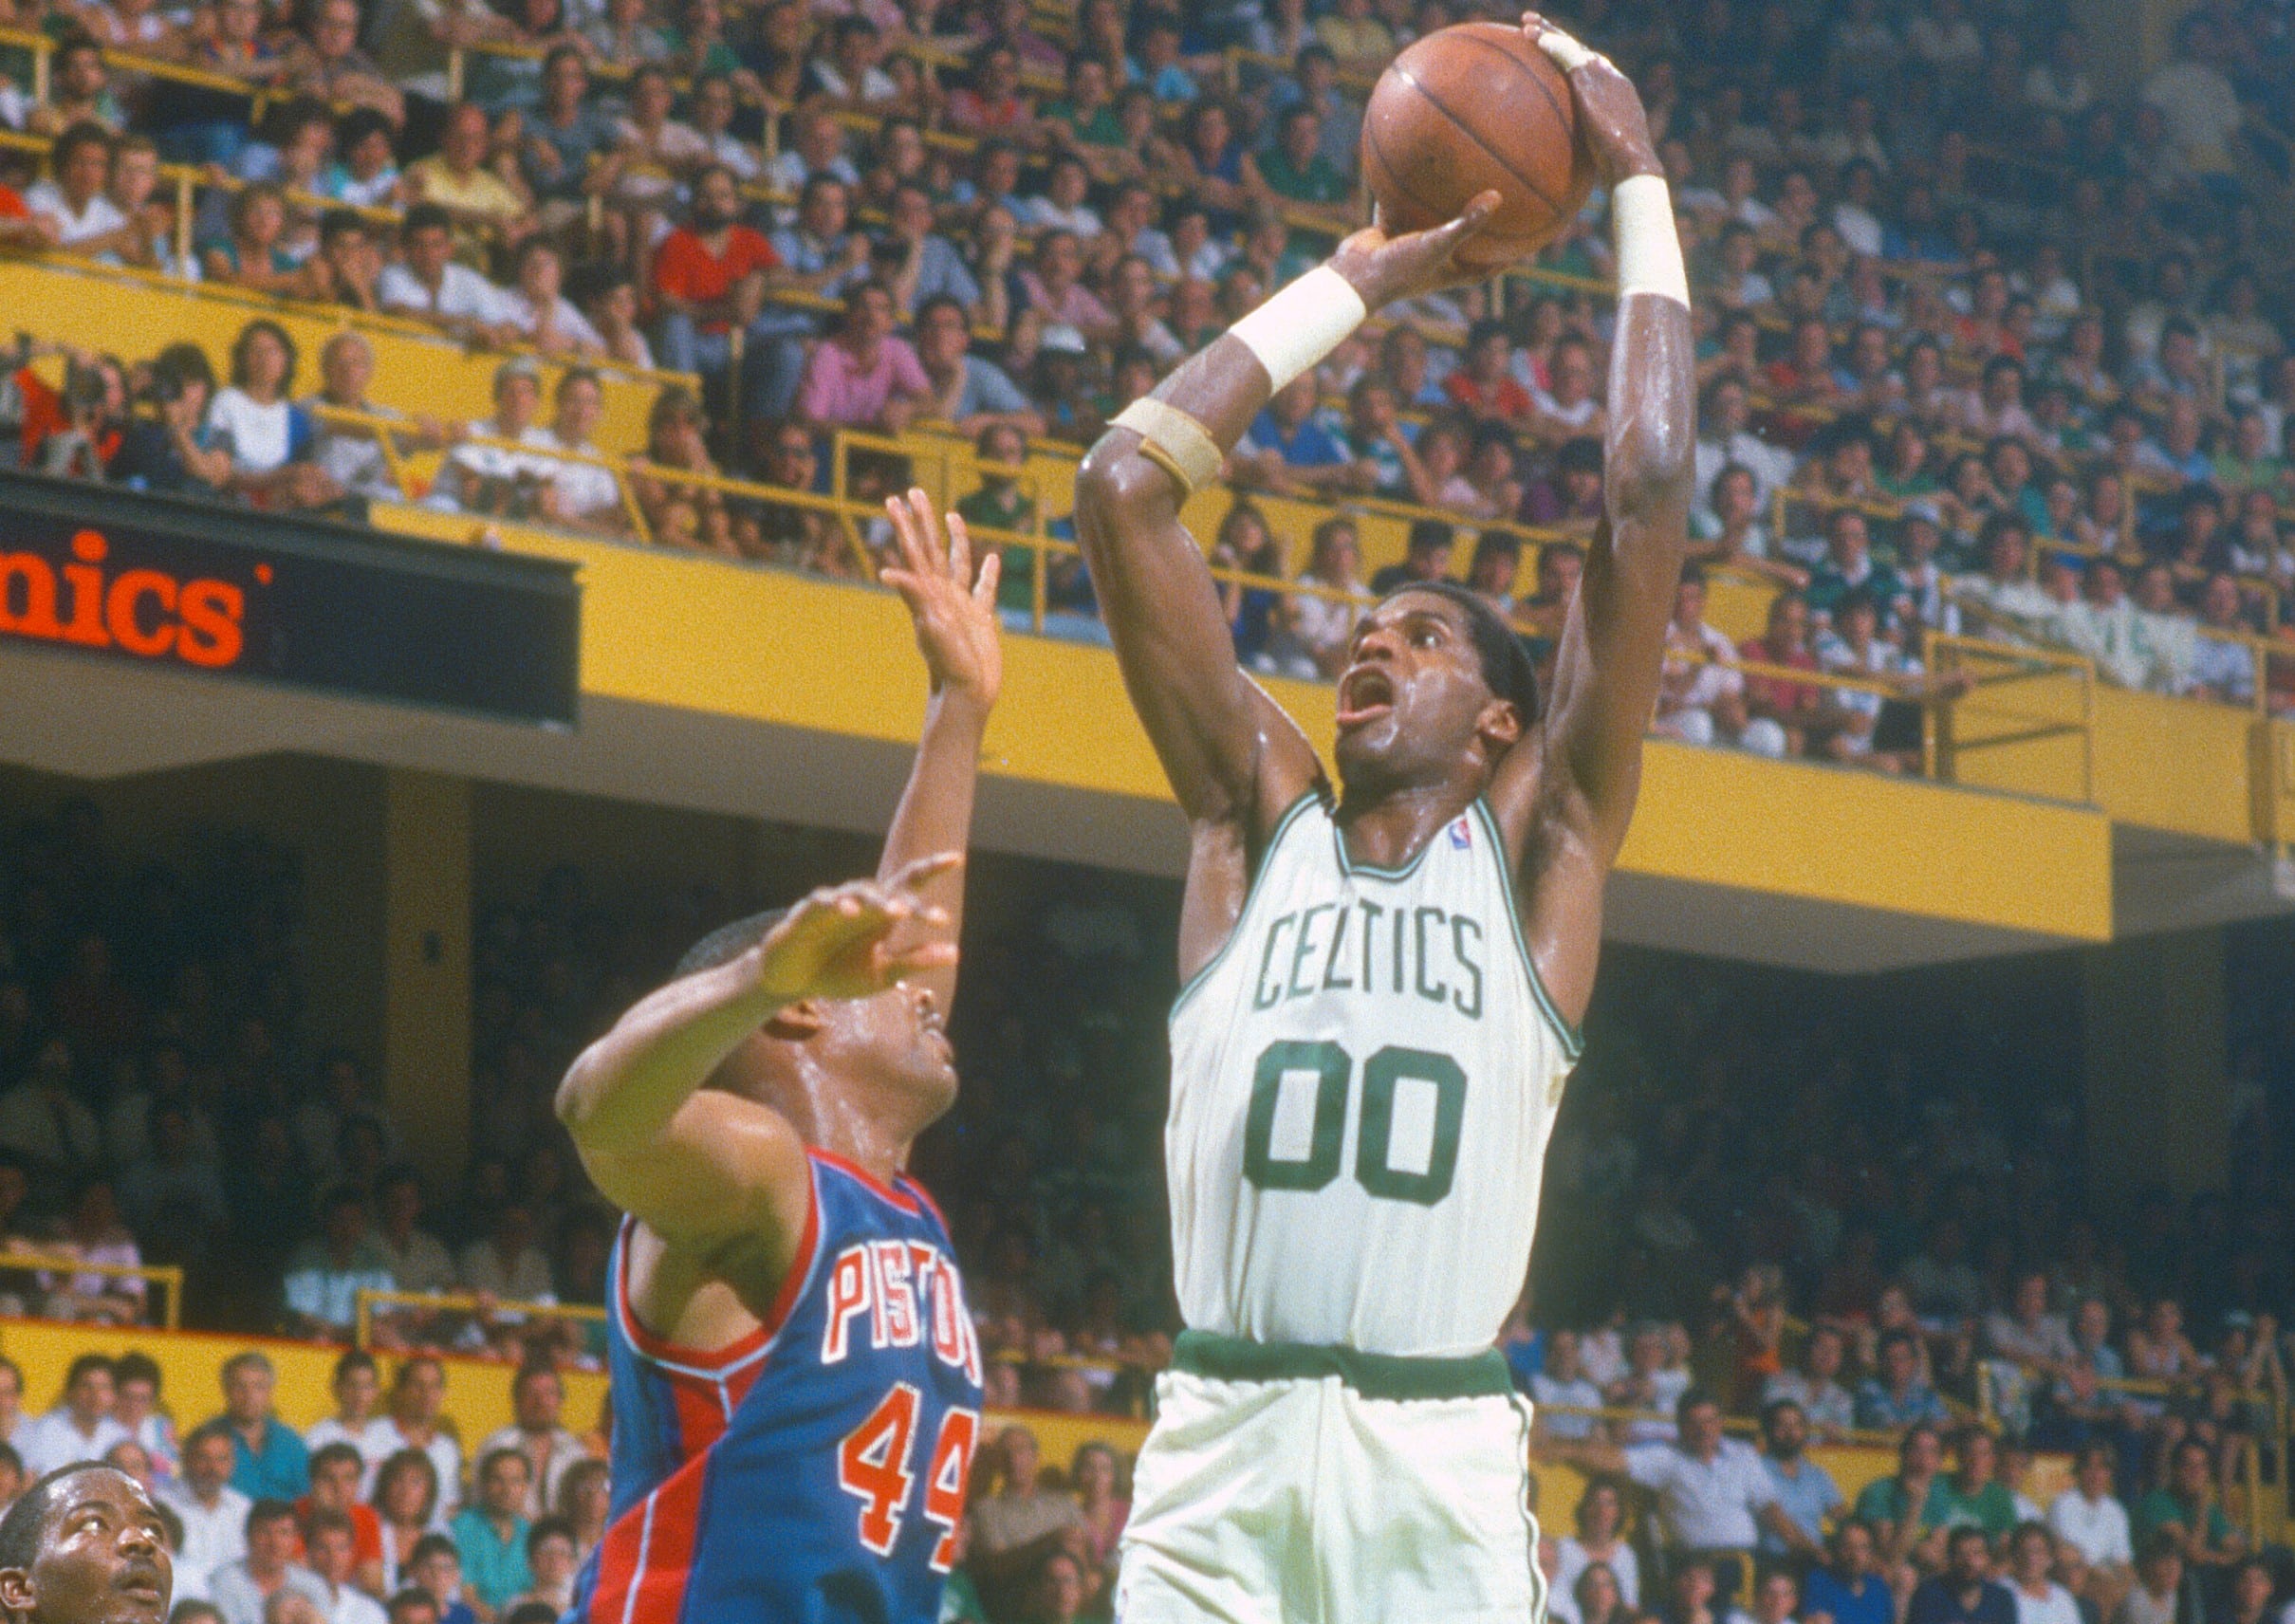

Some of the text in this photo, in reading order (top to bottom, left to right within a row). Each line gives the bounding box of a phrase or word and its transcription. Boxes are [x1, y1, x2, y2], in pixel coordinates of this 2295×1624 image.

[1252, 897, 1483, 1021] CELTICS
[1243, 1040, 1469, 1208] 00
[837, 1380, 980, 1575] 44
